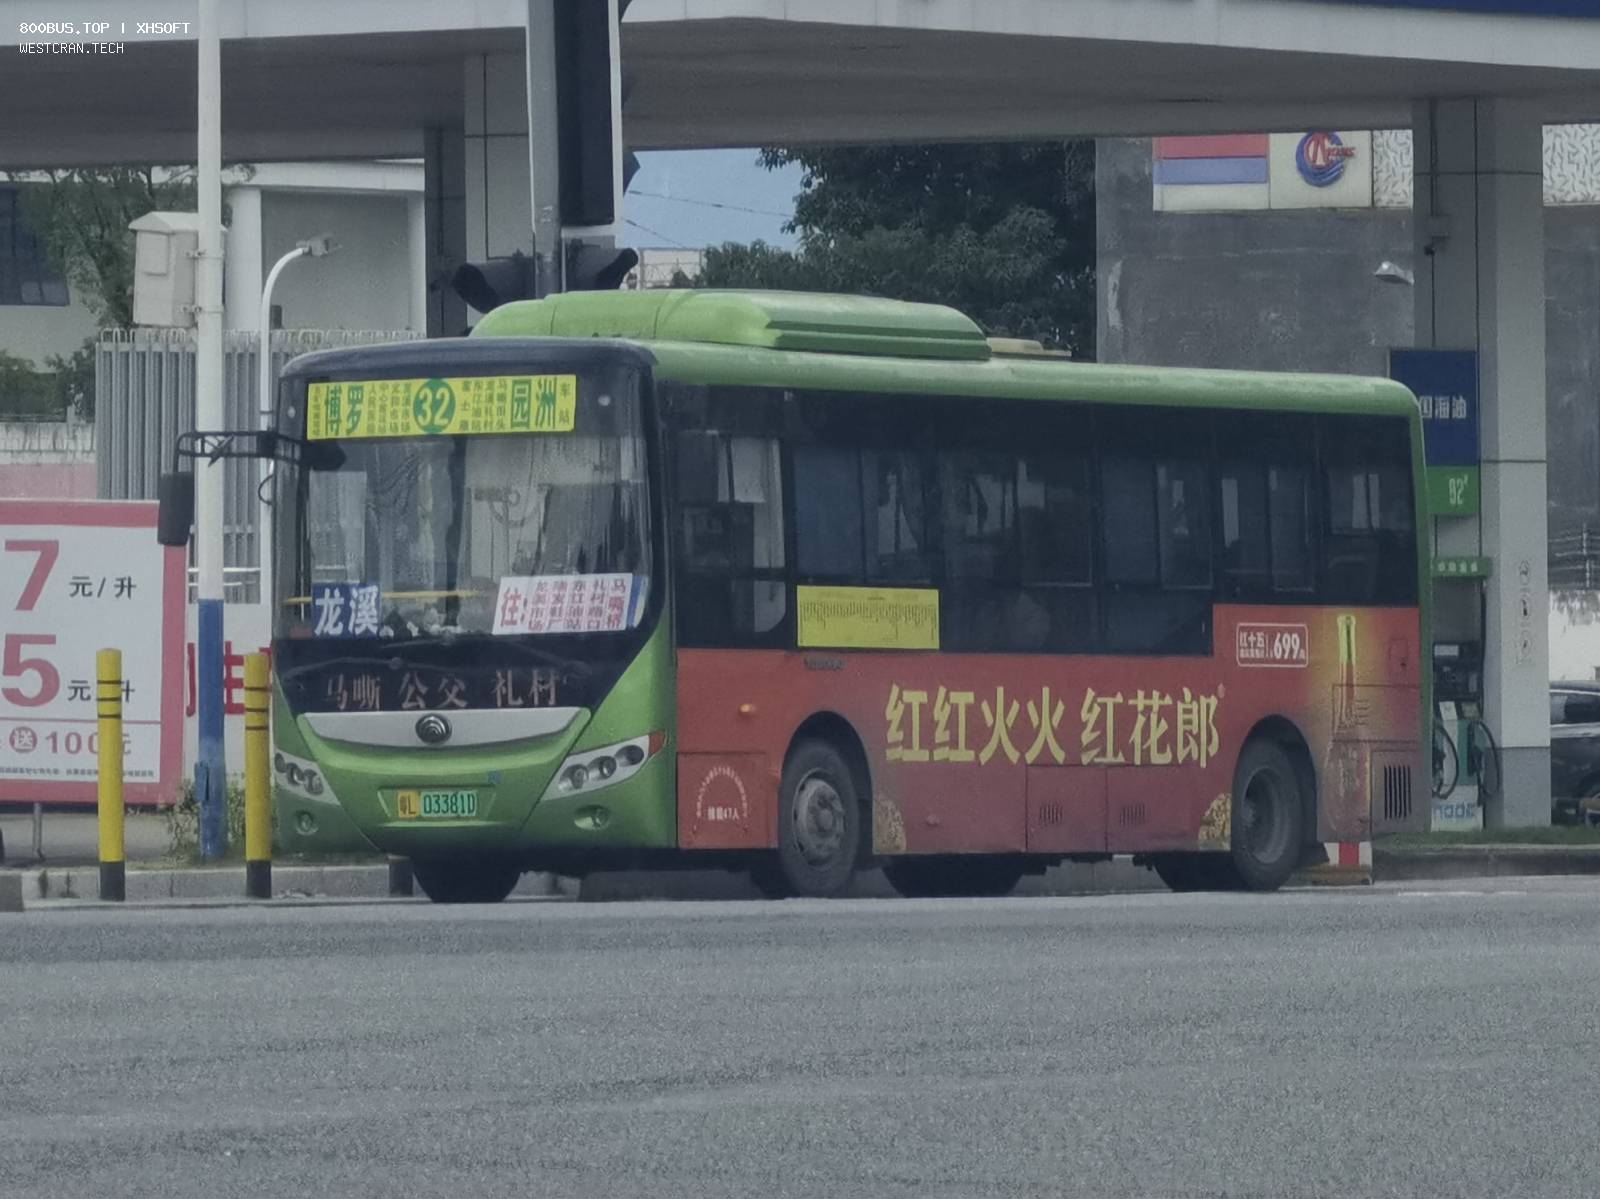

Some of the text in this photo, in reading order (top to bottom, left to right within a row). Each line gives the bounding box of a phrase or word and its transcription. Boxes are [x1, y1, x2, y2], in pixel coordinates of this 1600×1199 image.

[324, 384, 364, 436] 博罗
[417, 386, 450, 427] 32
[511, 377, 557, 430] 园洲
[5, 540, 137, 612] 7 元/升
[314, 587, 379, 636] 龙溪
[1, 634, 60, 707] 5
[1274, 632, 1299, 659] 699
[492, 669, 559, 707] 礼村
[885, 684, 1219, 768] 红红火火 红花郎
